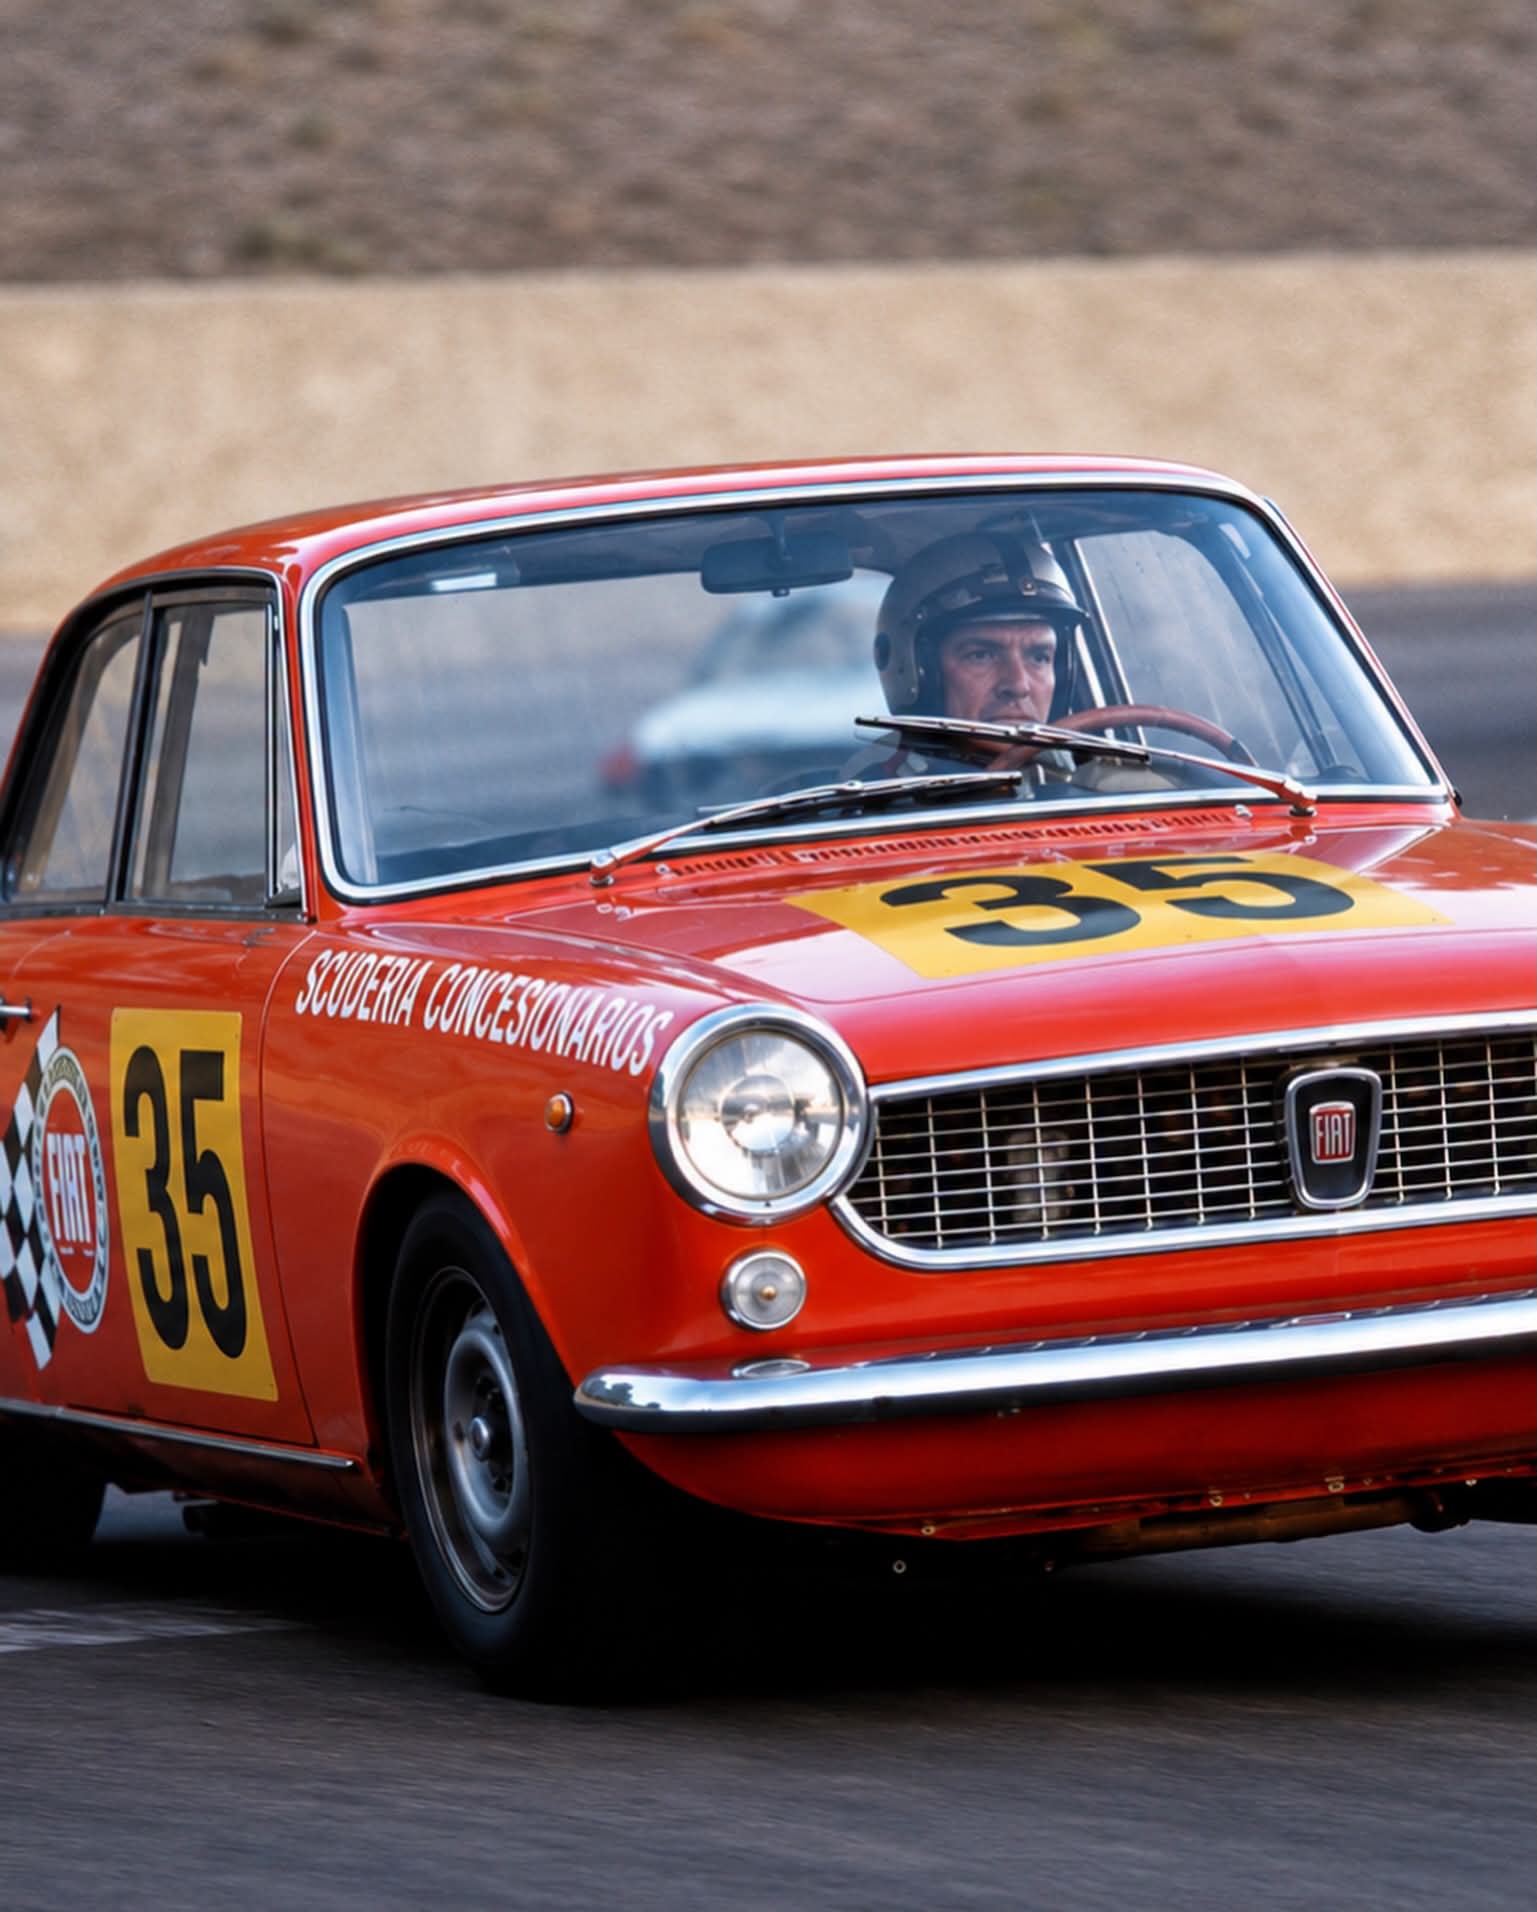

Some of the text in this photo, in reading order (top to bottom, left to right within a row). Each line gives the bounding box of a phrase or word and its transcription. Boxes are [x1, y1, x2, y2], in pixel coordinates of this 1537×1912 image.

[879, 855, 1354, 947] 35
[295, 949, 674, 1077] SCUDERIA CONCESIONARIOS
[46, 1132, 93, 1243] FIAT
[1315, 1113, 1351, 1157] FIAT
[122, 1045, 247, 1359] 35
